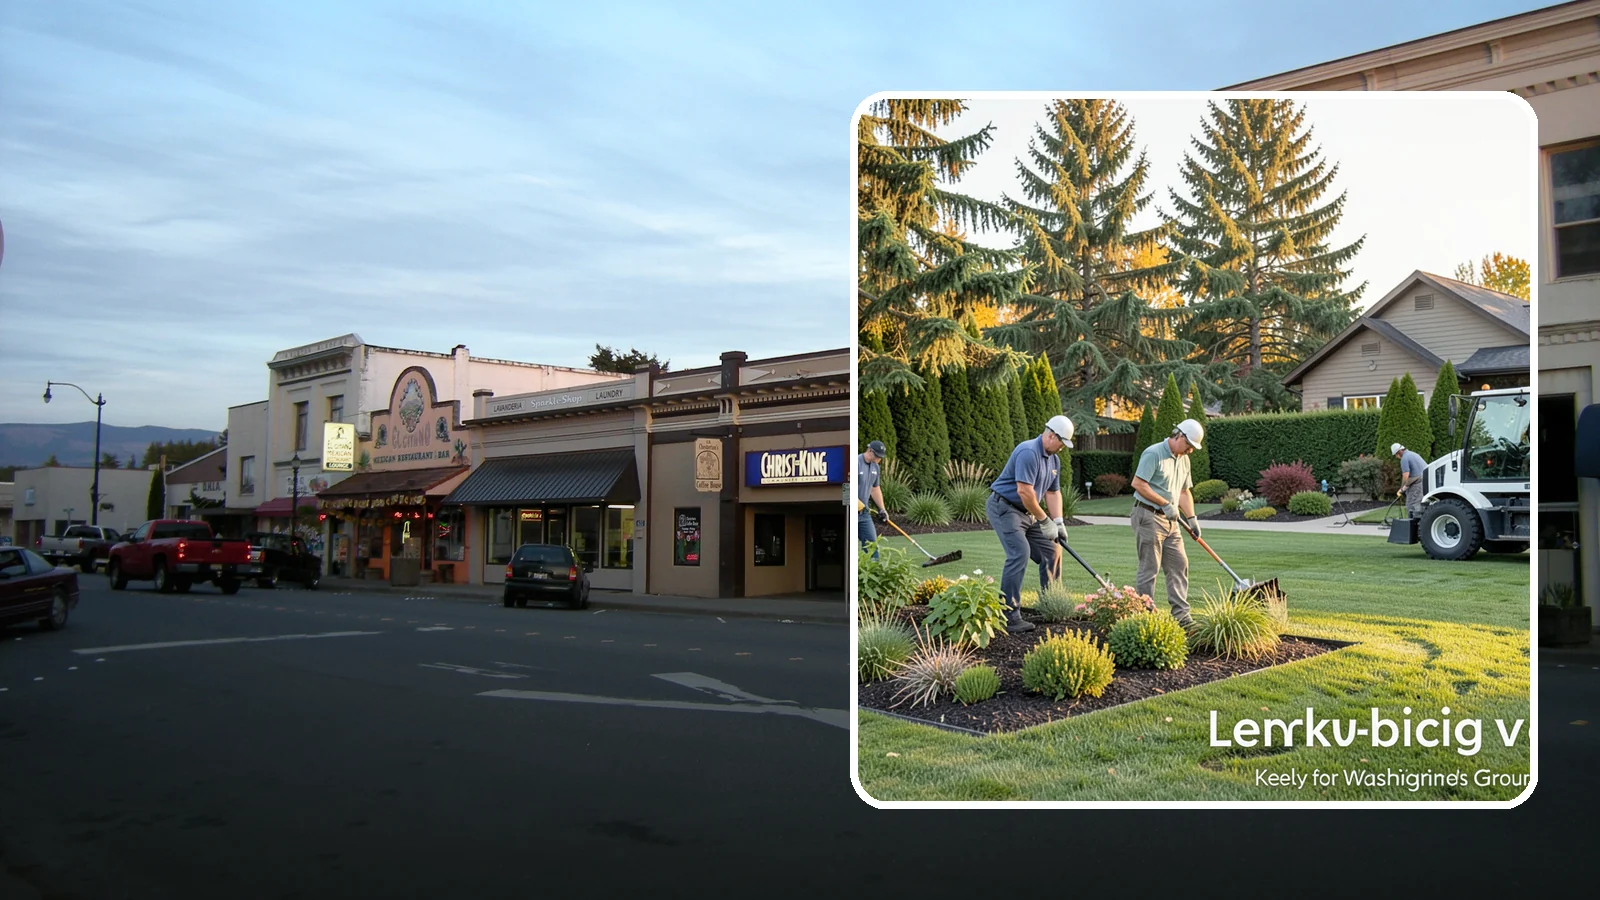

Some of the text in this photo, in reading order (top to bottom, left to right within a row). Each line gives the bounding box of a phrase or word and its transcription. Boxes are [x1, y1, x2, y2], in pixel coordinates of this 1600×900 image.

[530, 394, 583, 409] Sparkle Shop
[595, 389, 623, 400] LAUNDRY
[493, 402, 523, 413] LAVANDERIA
[373, 450, 450, 464] MEXICAN RESTAURANT BAR
[761, 450, 827, 478] CHRIST KING
